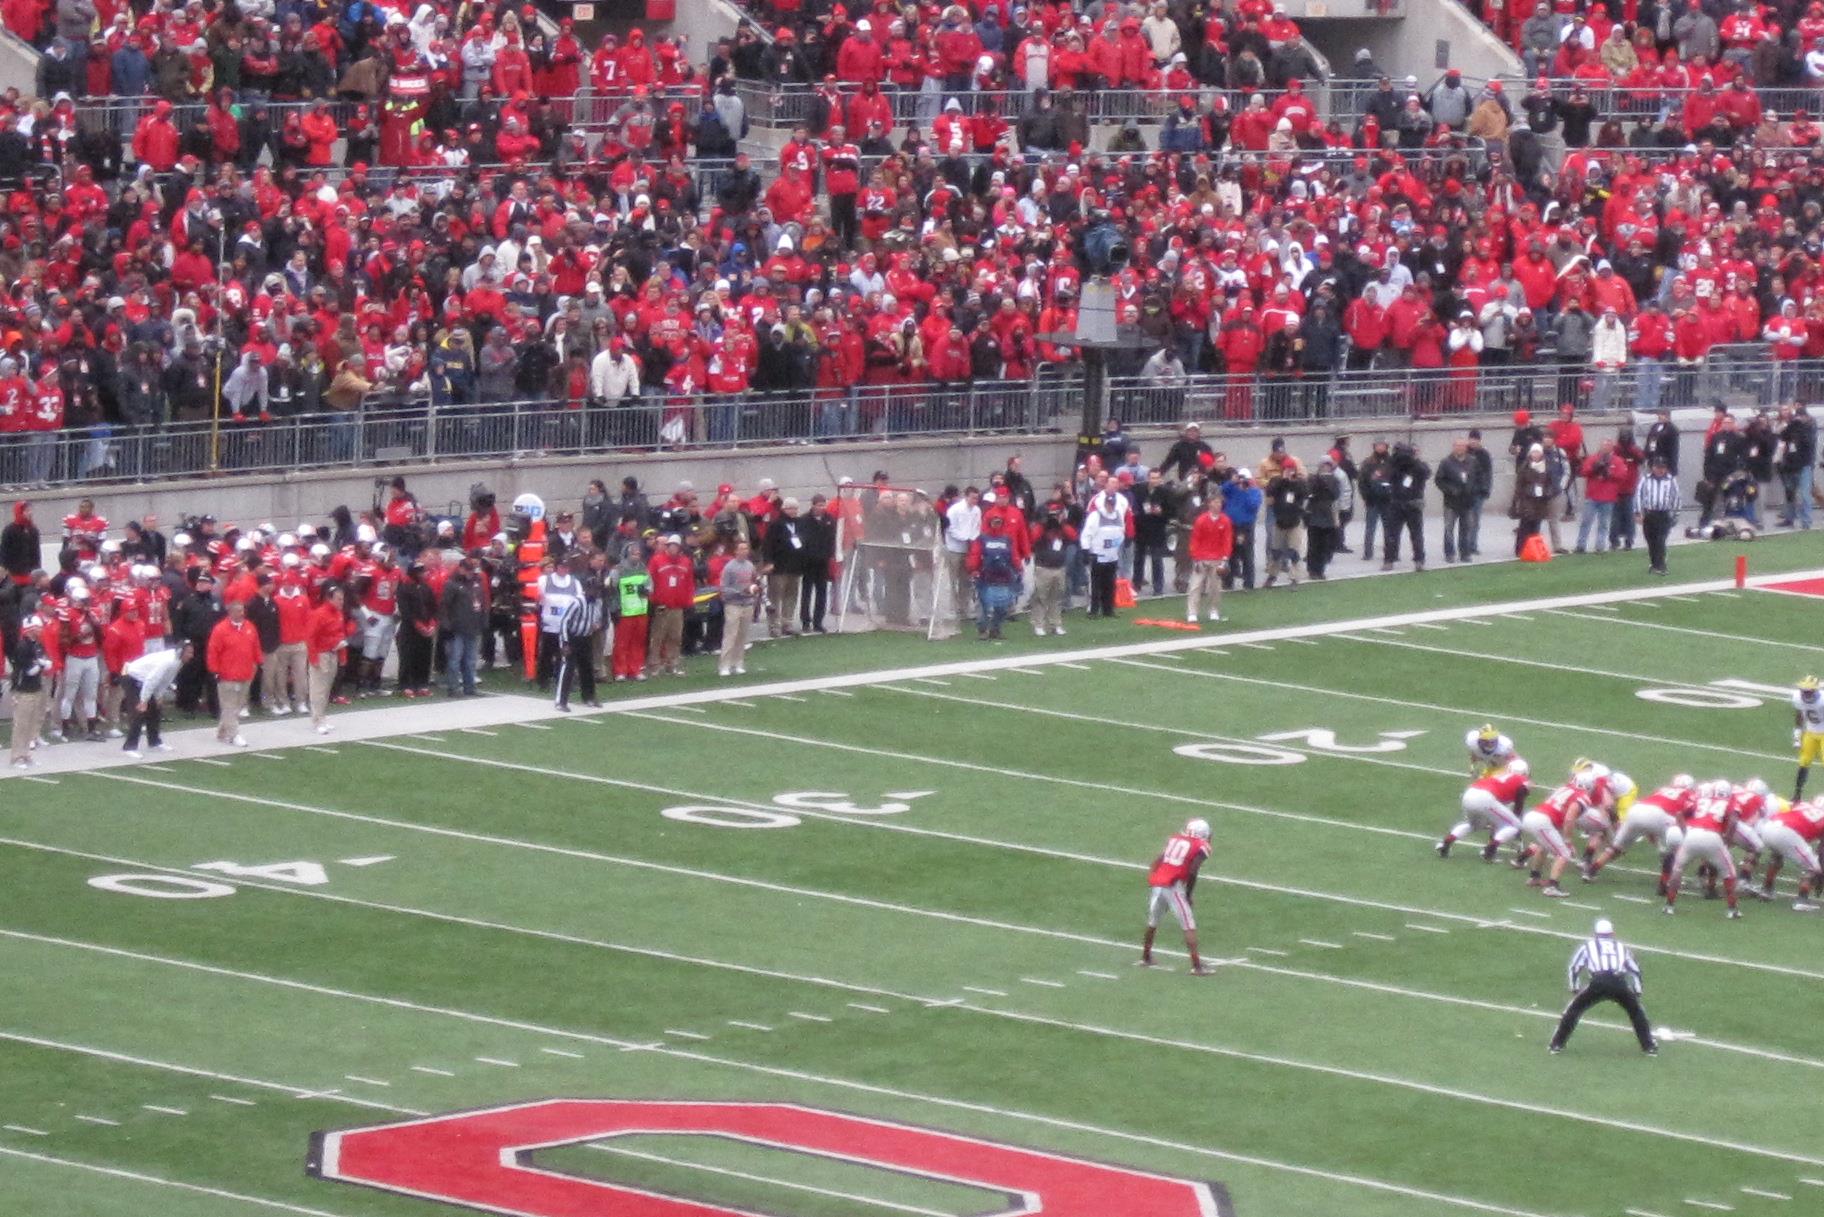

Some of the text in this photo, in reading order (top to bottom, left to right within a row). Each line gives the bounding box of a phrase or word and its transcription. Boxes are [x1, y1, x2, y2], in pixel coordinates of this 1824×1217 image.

[604, 60, 617, 81] 7
[867, 195, 886, 211] 22
[1163, 838, 1191, 867] 10
